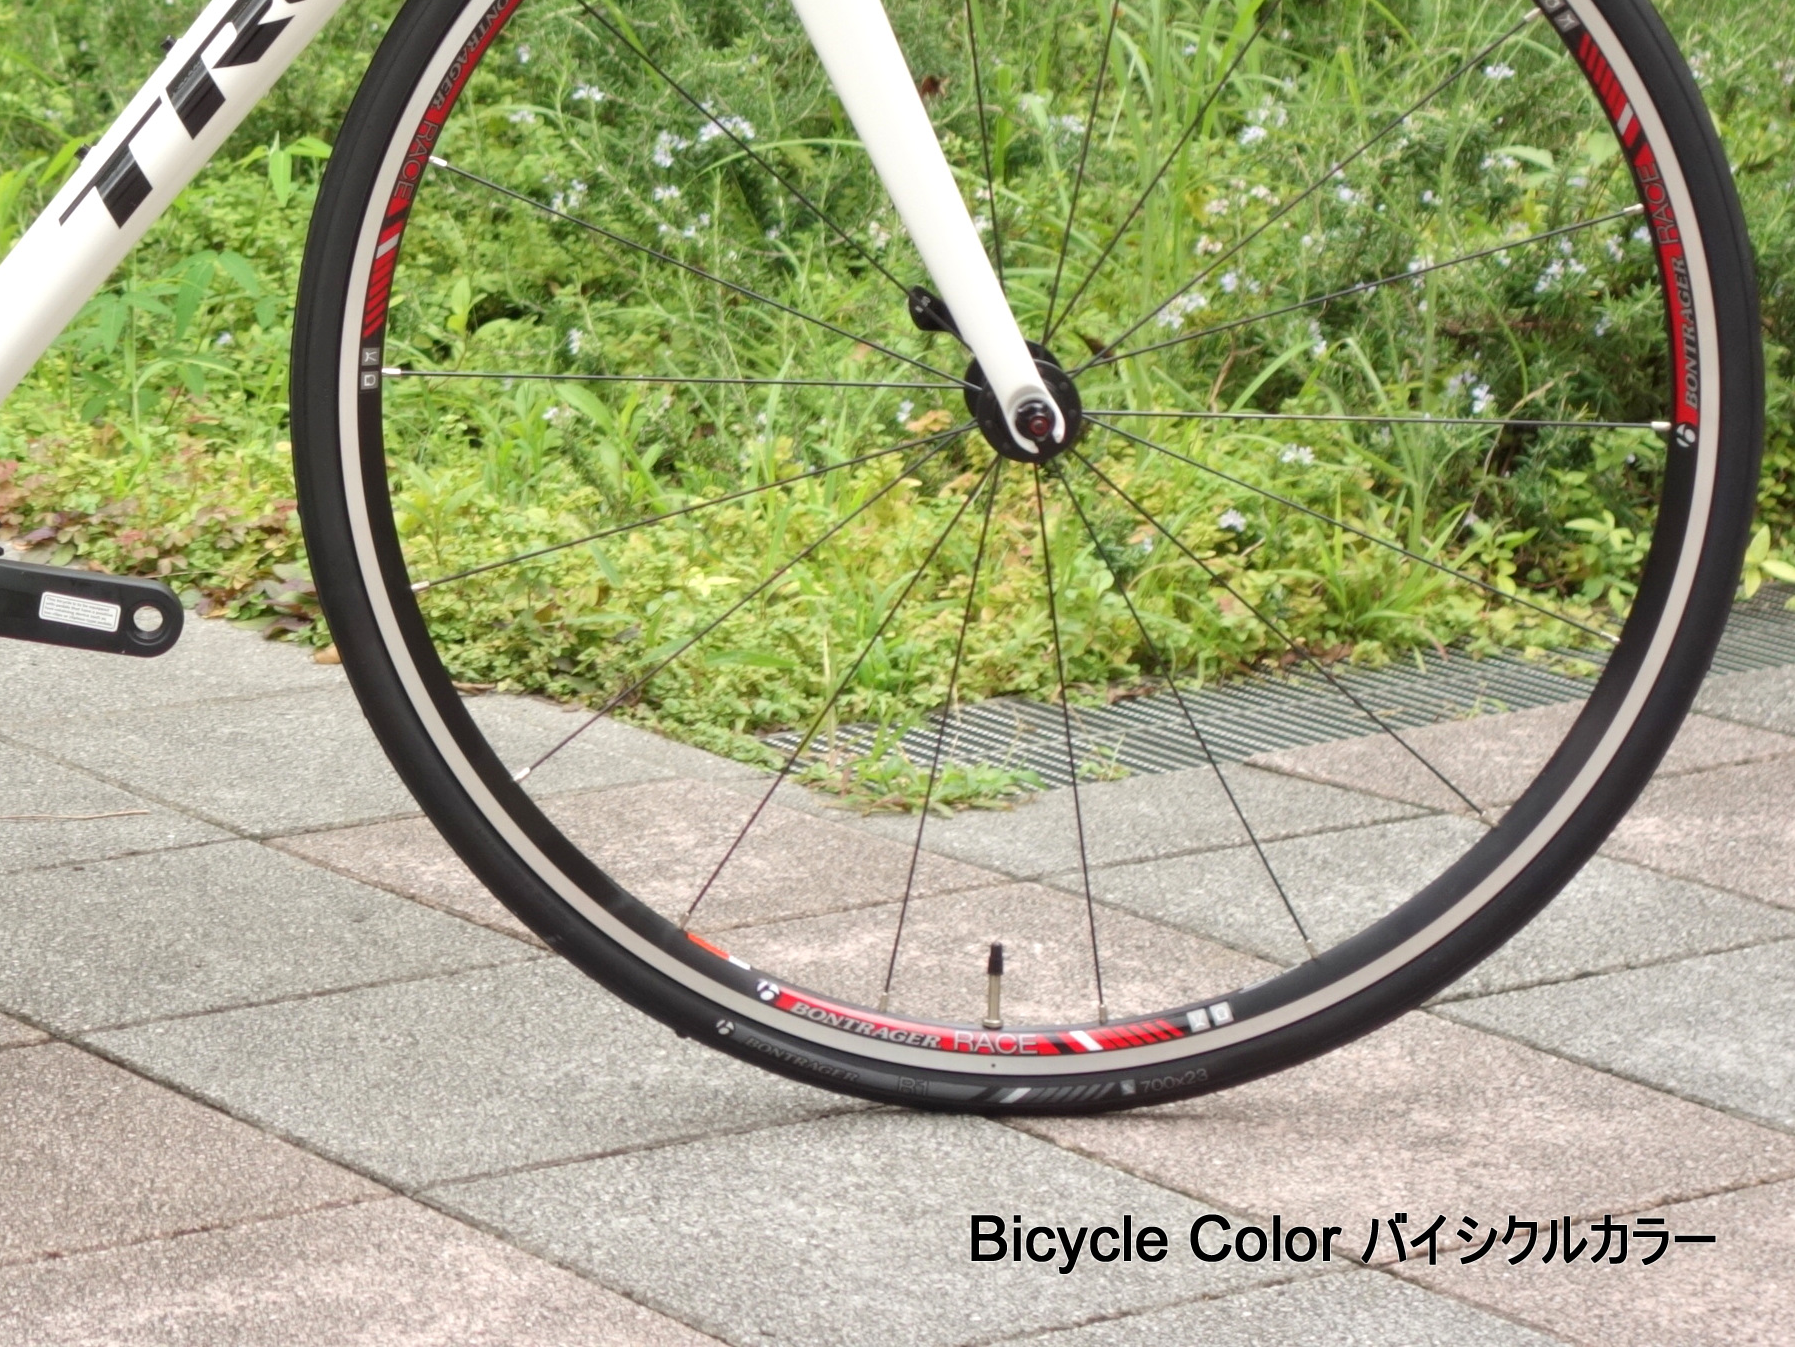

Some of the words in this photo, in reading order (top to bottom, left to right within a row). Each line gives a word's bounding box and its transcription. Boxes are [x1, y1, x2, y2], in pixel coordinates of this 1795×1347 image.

[394, 120, 439, 199] RACE
[1637, 161, 1682, 247] RACE
[1669, 255, 1700, 410] BONTRAGER
[744, 1035, 861, 1083] BONTRAGER
[1140, 1068, 1211, 1094] 700x23
[789, 1000, 941, 1049] BONTRAGER
[953, 1031, 1040, 1055] RACE
